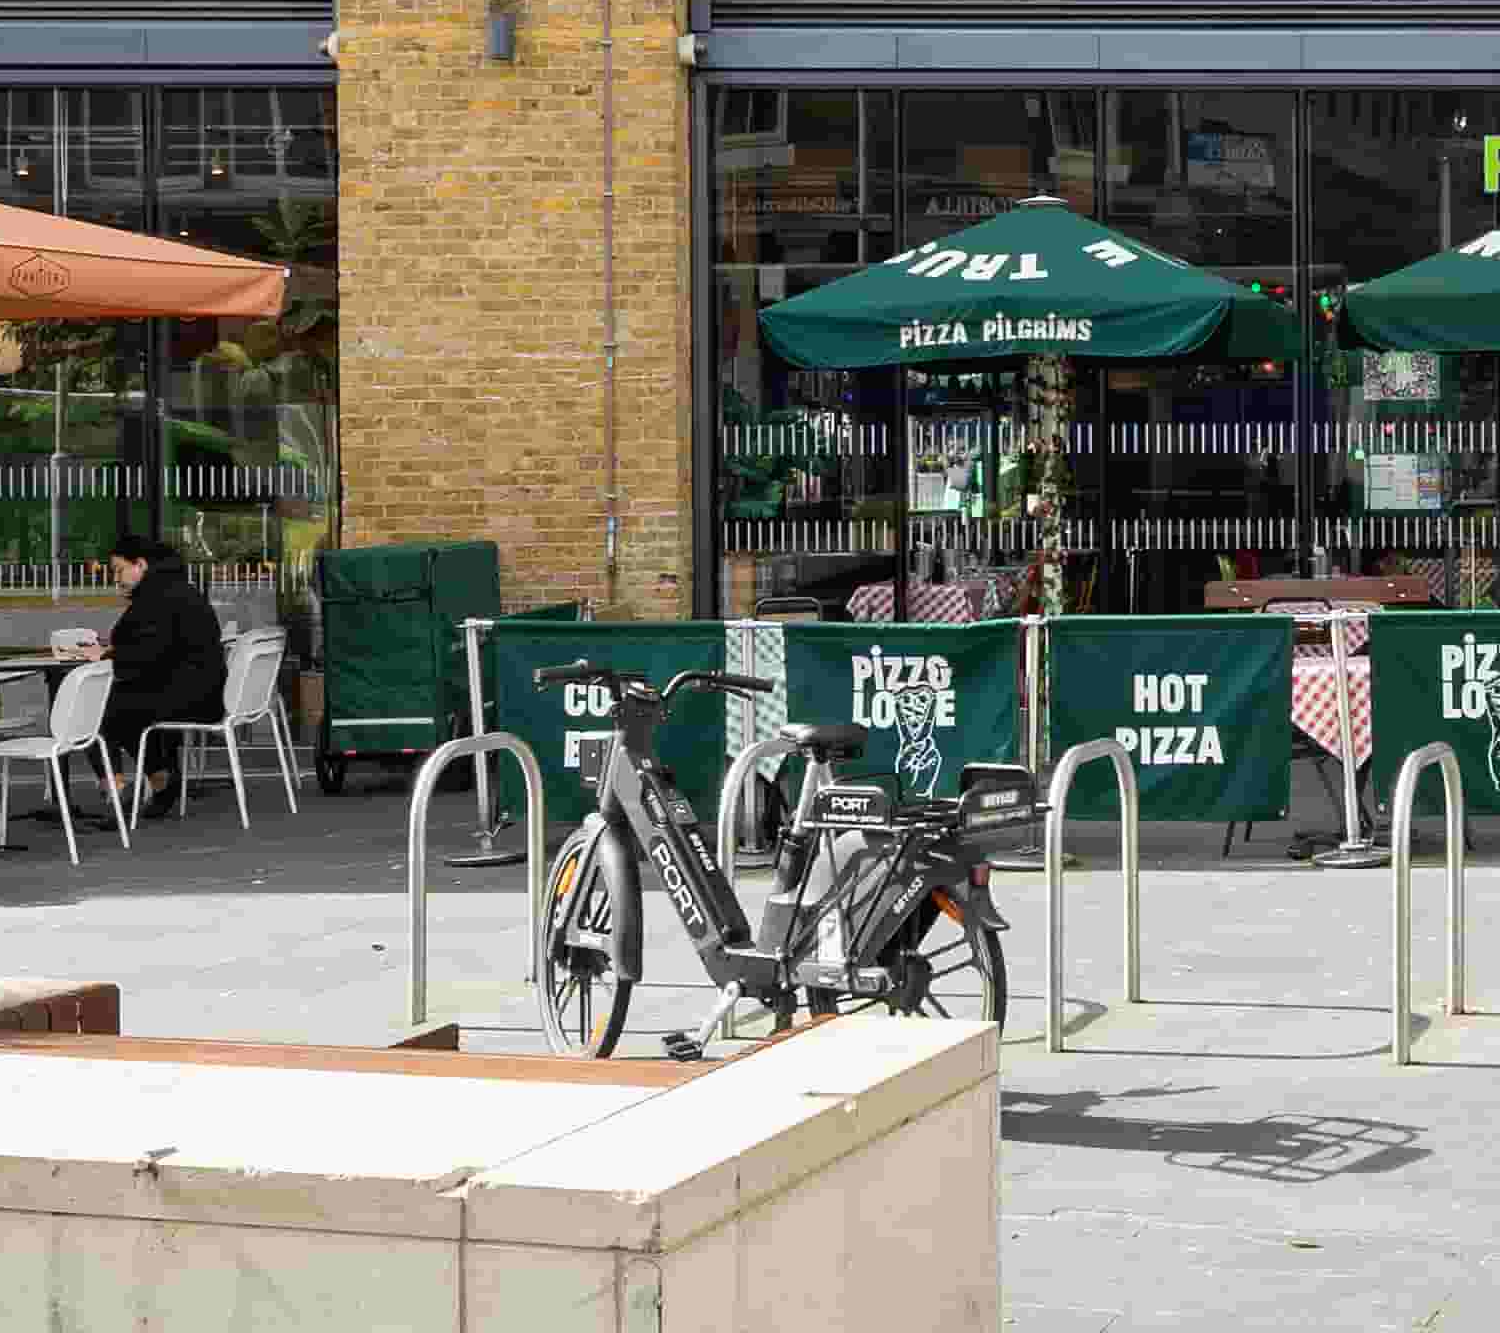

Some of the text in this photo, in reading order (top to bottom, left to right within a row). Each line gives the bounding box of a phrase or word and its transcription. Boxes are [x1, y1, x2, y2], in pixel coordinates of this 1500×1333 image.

[900, 311, 1093, 349] PIZZA PILGRIMS
[1133, 674, 1208, 713] HOT
[1114, 727, 1225, 765] PIZZA
[830, 797, 871, 813] PORT
[651, 842, 704, 926] PORT
